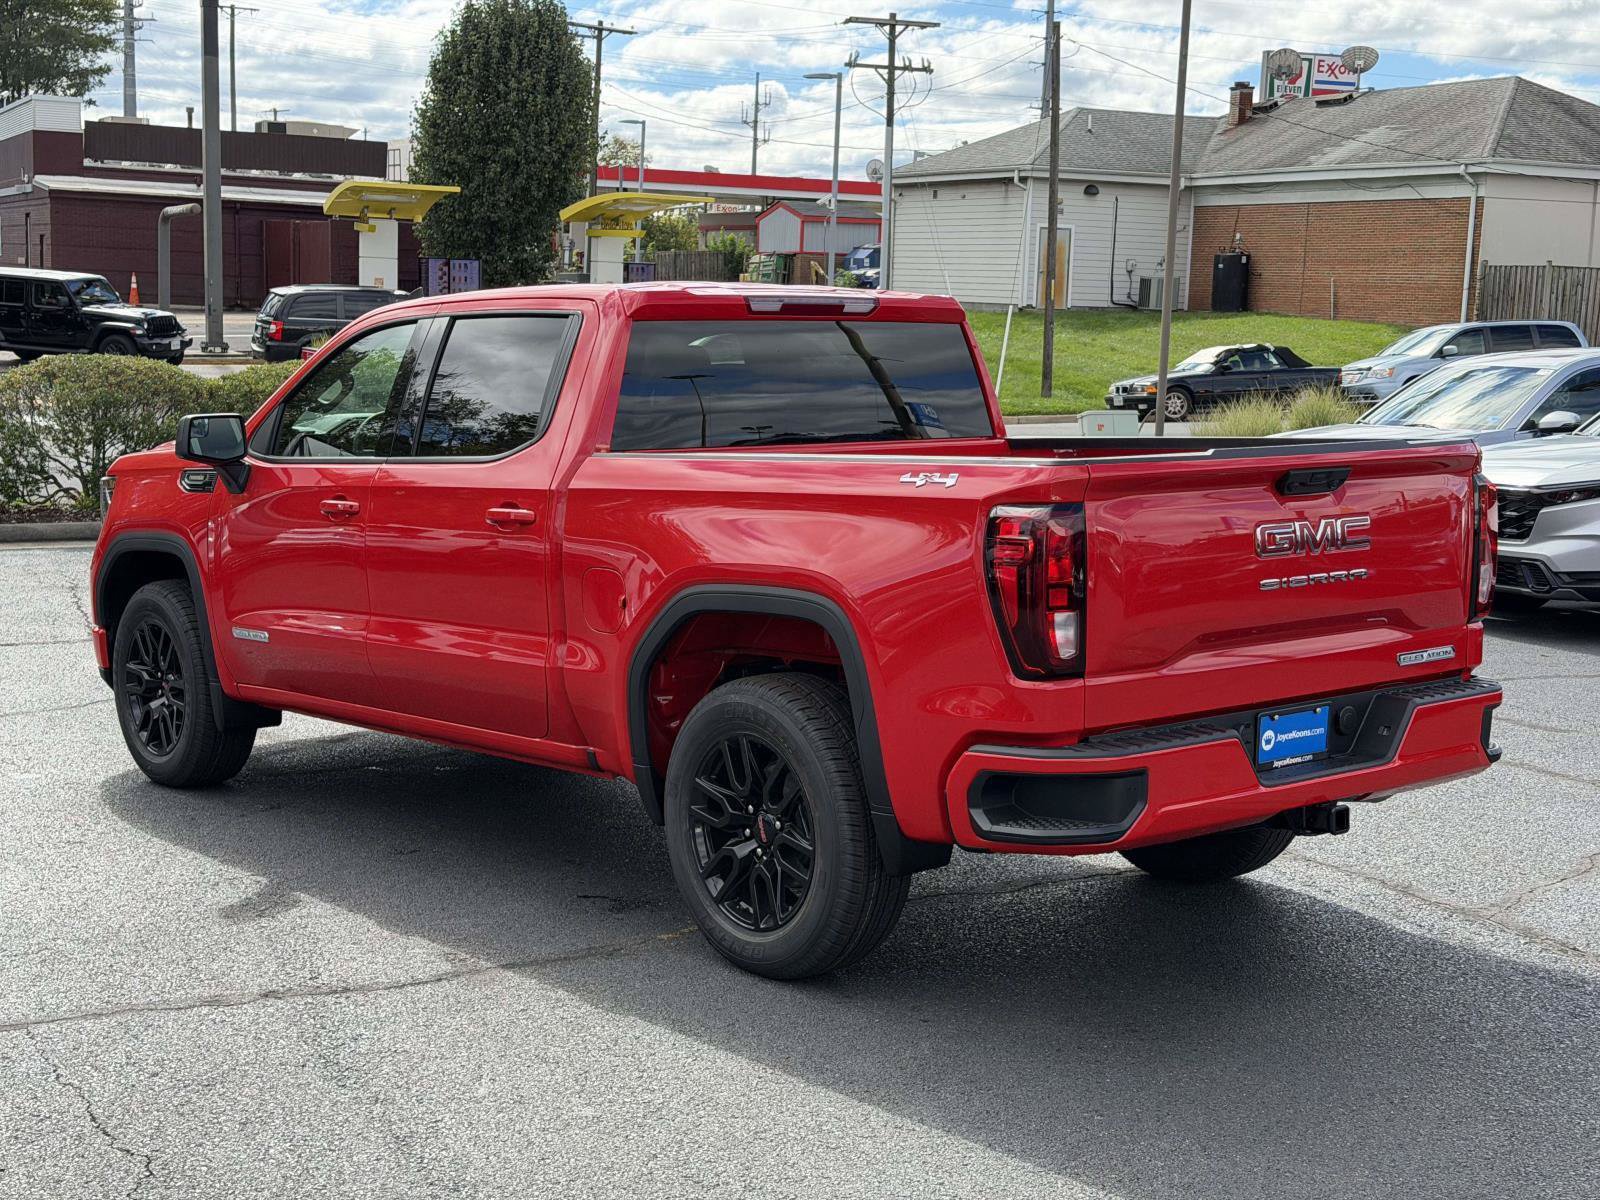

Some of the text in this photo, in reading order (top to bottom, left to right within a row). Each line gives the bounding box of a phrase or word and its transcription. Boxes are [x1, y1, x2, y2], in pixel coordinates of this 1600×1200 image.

[1255, 515, 1370, 559] GMC
[1260, 568, 1369, 590] SIERRA
[1401, 648, 1453, 663] ELEVATION
[1275, 727, 1325, 743] JoyceKoons.com
[1272, 754, 1313, 768] JoyceKoons.com
